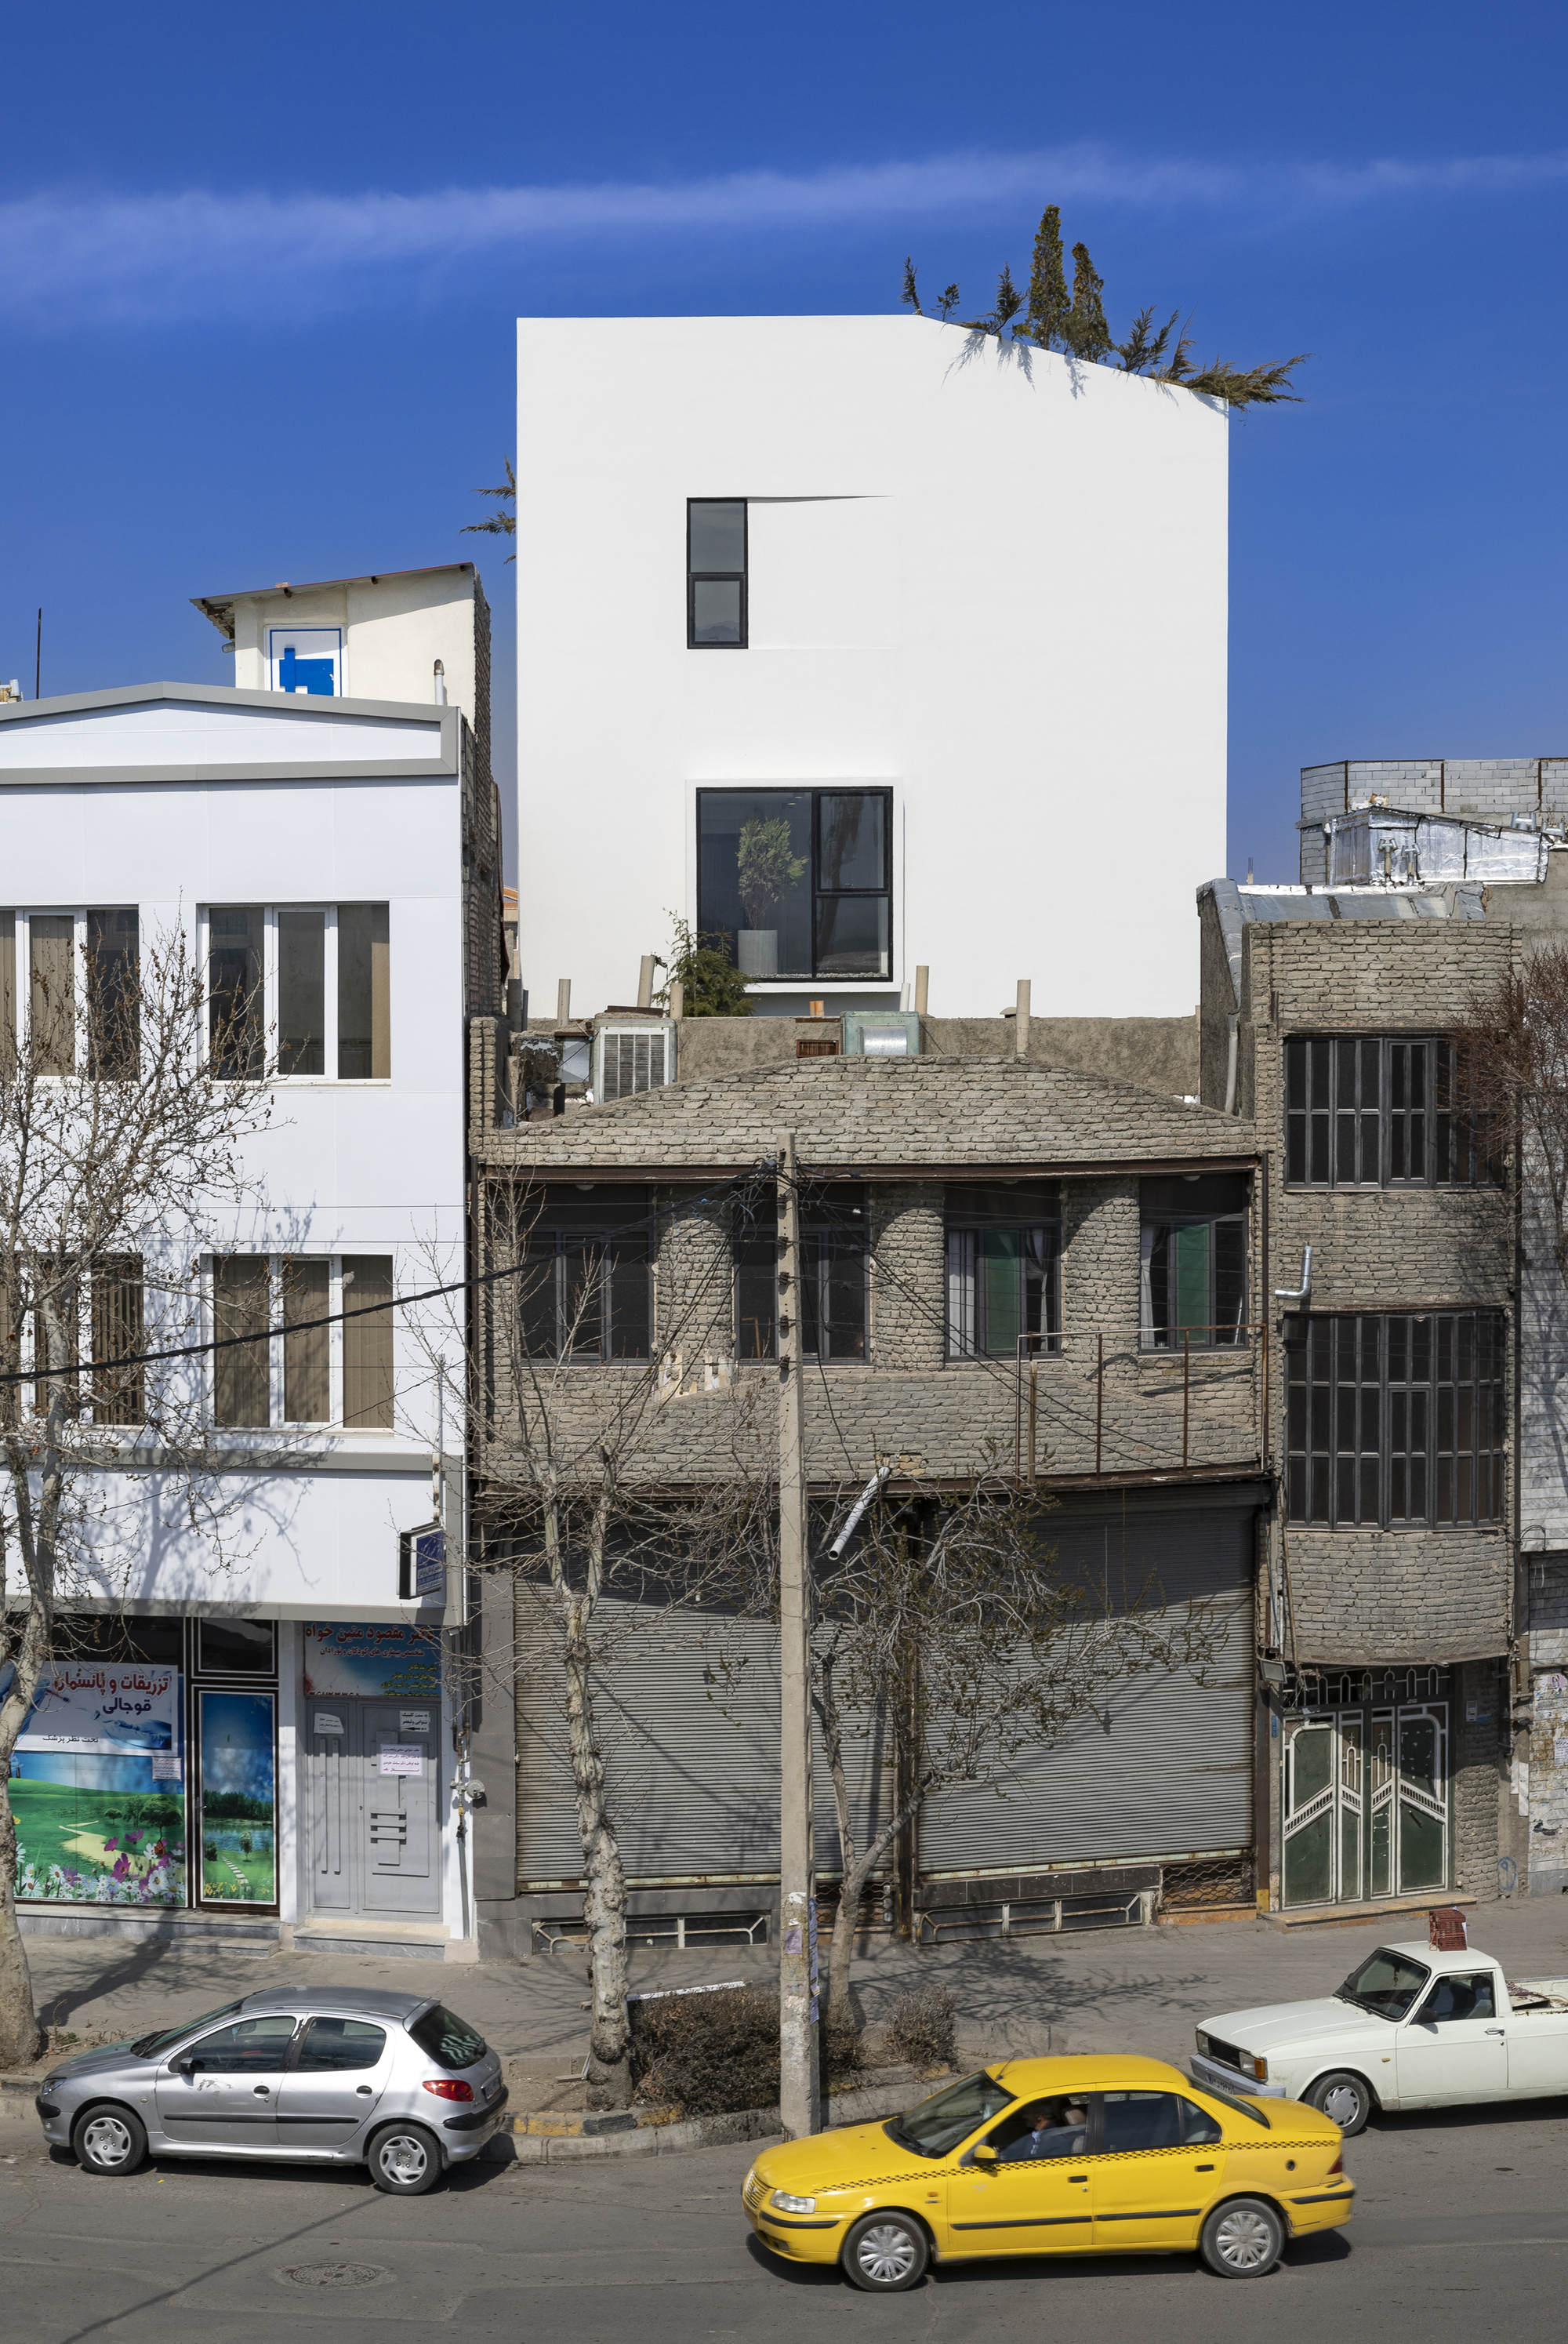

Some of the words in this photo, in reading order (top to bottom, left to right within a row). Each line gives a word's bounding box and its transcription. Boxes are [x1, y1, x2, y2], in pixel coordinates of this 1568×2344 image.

[305, 1623, 334, 1642] خواه
[336, 1626, 364, 1643] متین
[366, 1626, 405, 1644] مقصود
[320, 1646, 342, 1656] نوزادان
[347, 1647, 368, 1657] کودکان
[368, 1647, 381, 1657] های
[382, 1648, 401, 1657] بیماری
[401, 1648, 425, 1657] متخصص
[53, 1671, 106, 1695] پانسمان
[109, 1677, 118, 1695] و
[120, 1673, 169, 1696] تزریقات
[102, 1697, 152, 1716] قوجالی
[42, 1735, 65, 1744] پزشک
[66, 1735, 80, 1744] نظر
